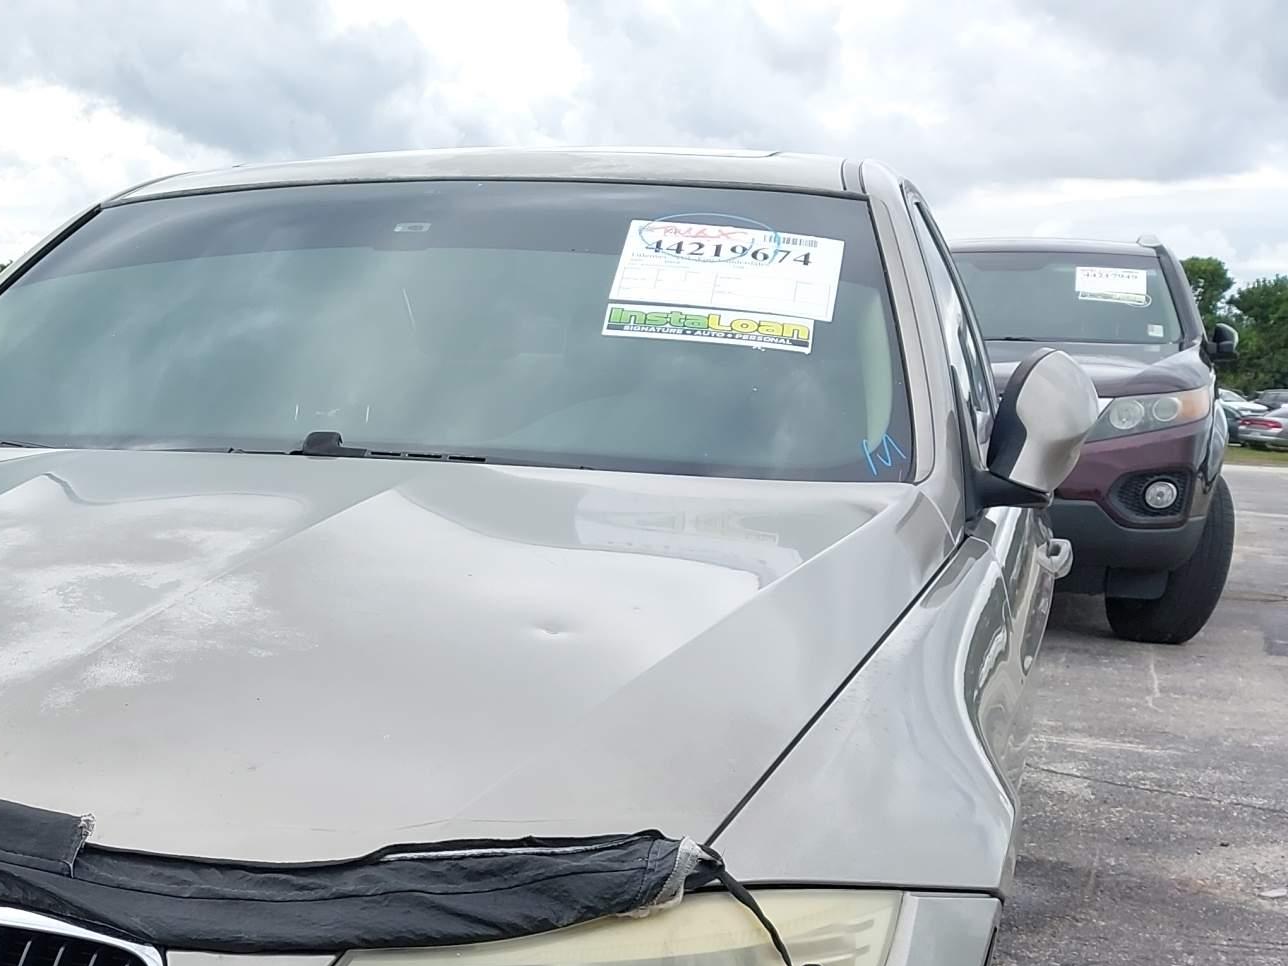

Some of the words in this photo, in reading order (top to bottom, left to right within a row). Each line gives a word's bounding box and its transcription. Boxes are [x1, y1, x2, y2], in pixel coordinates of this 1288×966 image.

[645, 239, 812, 266] 44219674
[608, 306, 811, 340] InstaLoan
[623, 325, 683, 335] SIGNATURE
[694, 330, 725, 338] AUTO
[734, 333, 793, 345] PERSONAL
